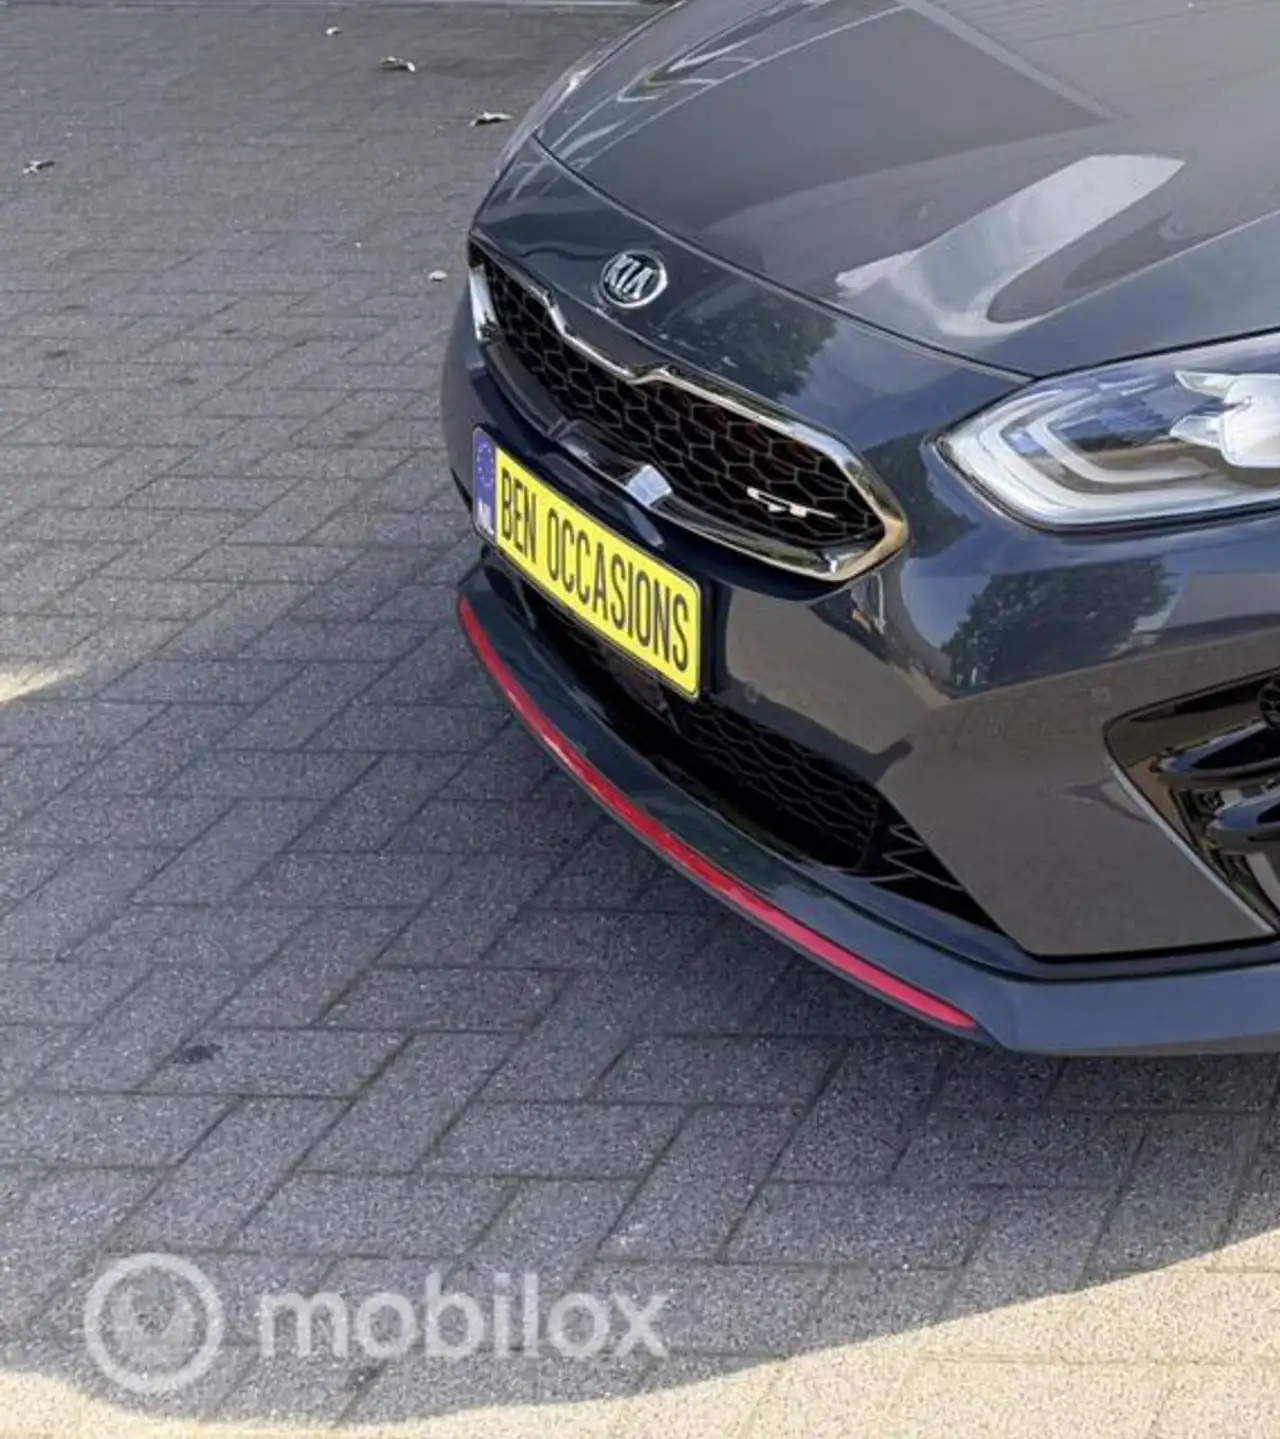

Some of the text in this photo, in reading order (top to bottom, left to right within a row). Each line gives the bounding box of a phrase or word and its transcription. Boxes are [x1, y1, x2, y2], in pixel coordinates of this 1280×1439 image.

[605, 254, 653, 300] KIA
[501, 467, 689, 672] BEN OCCASIONS
